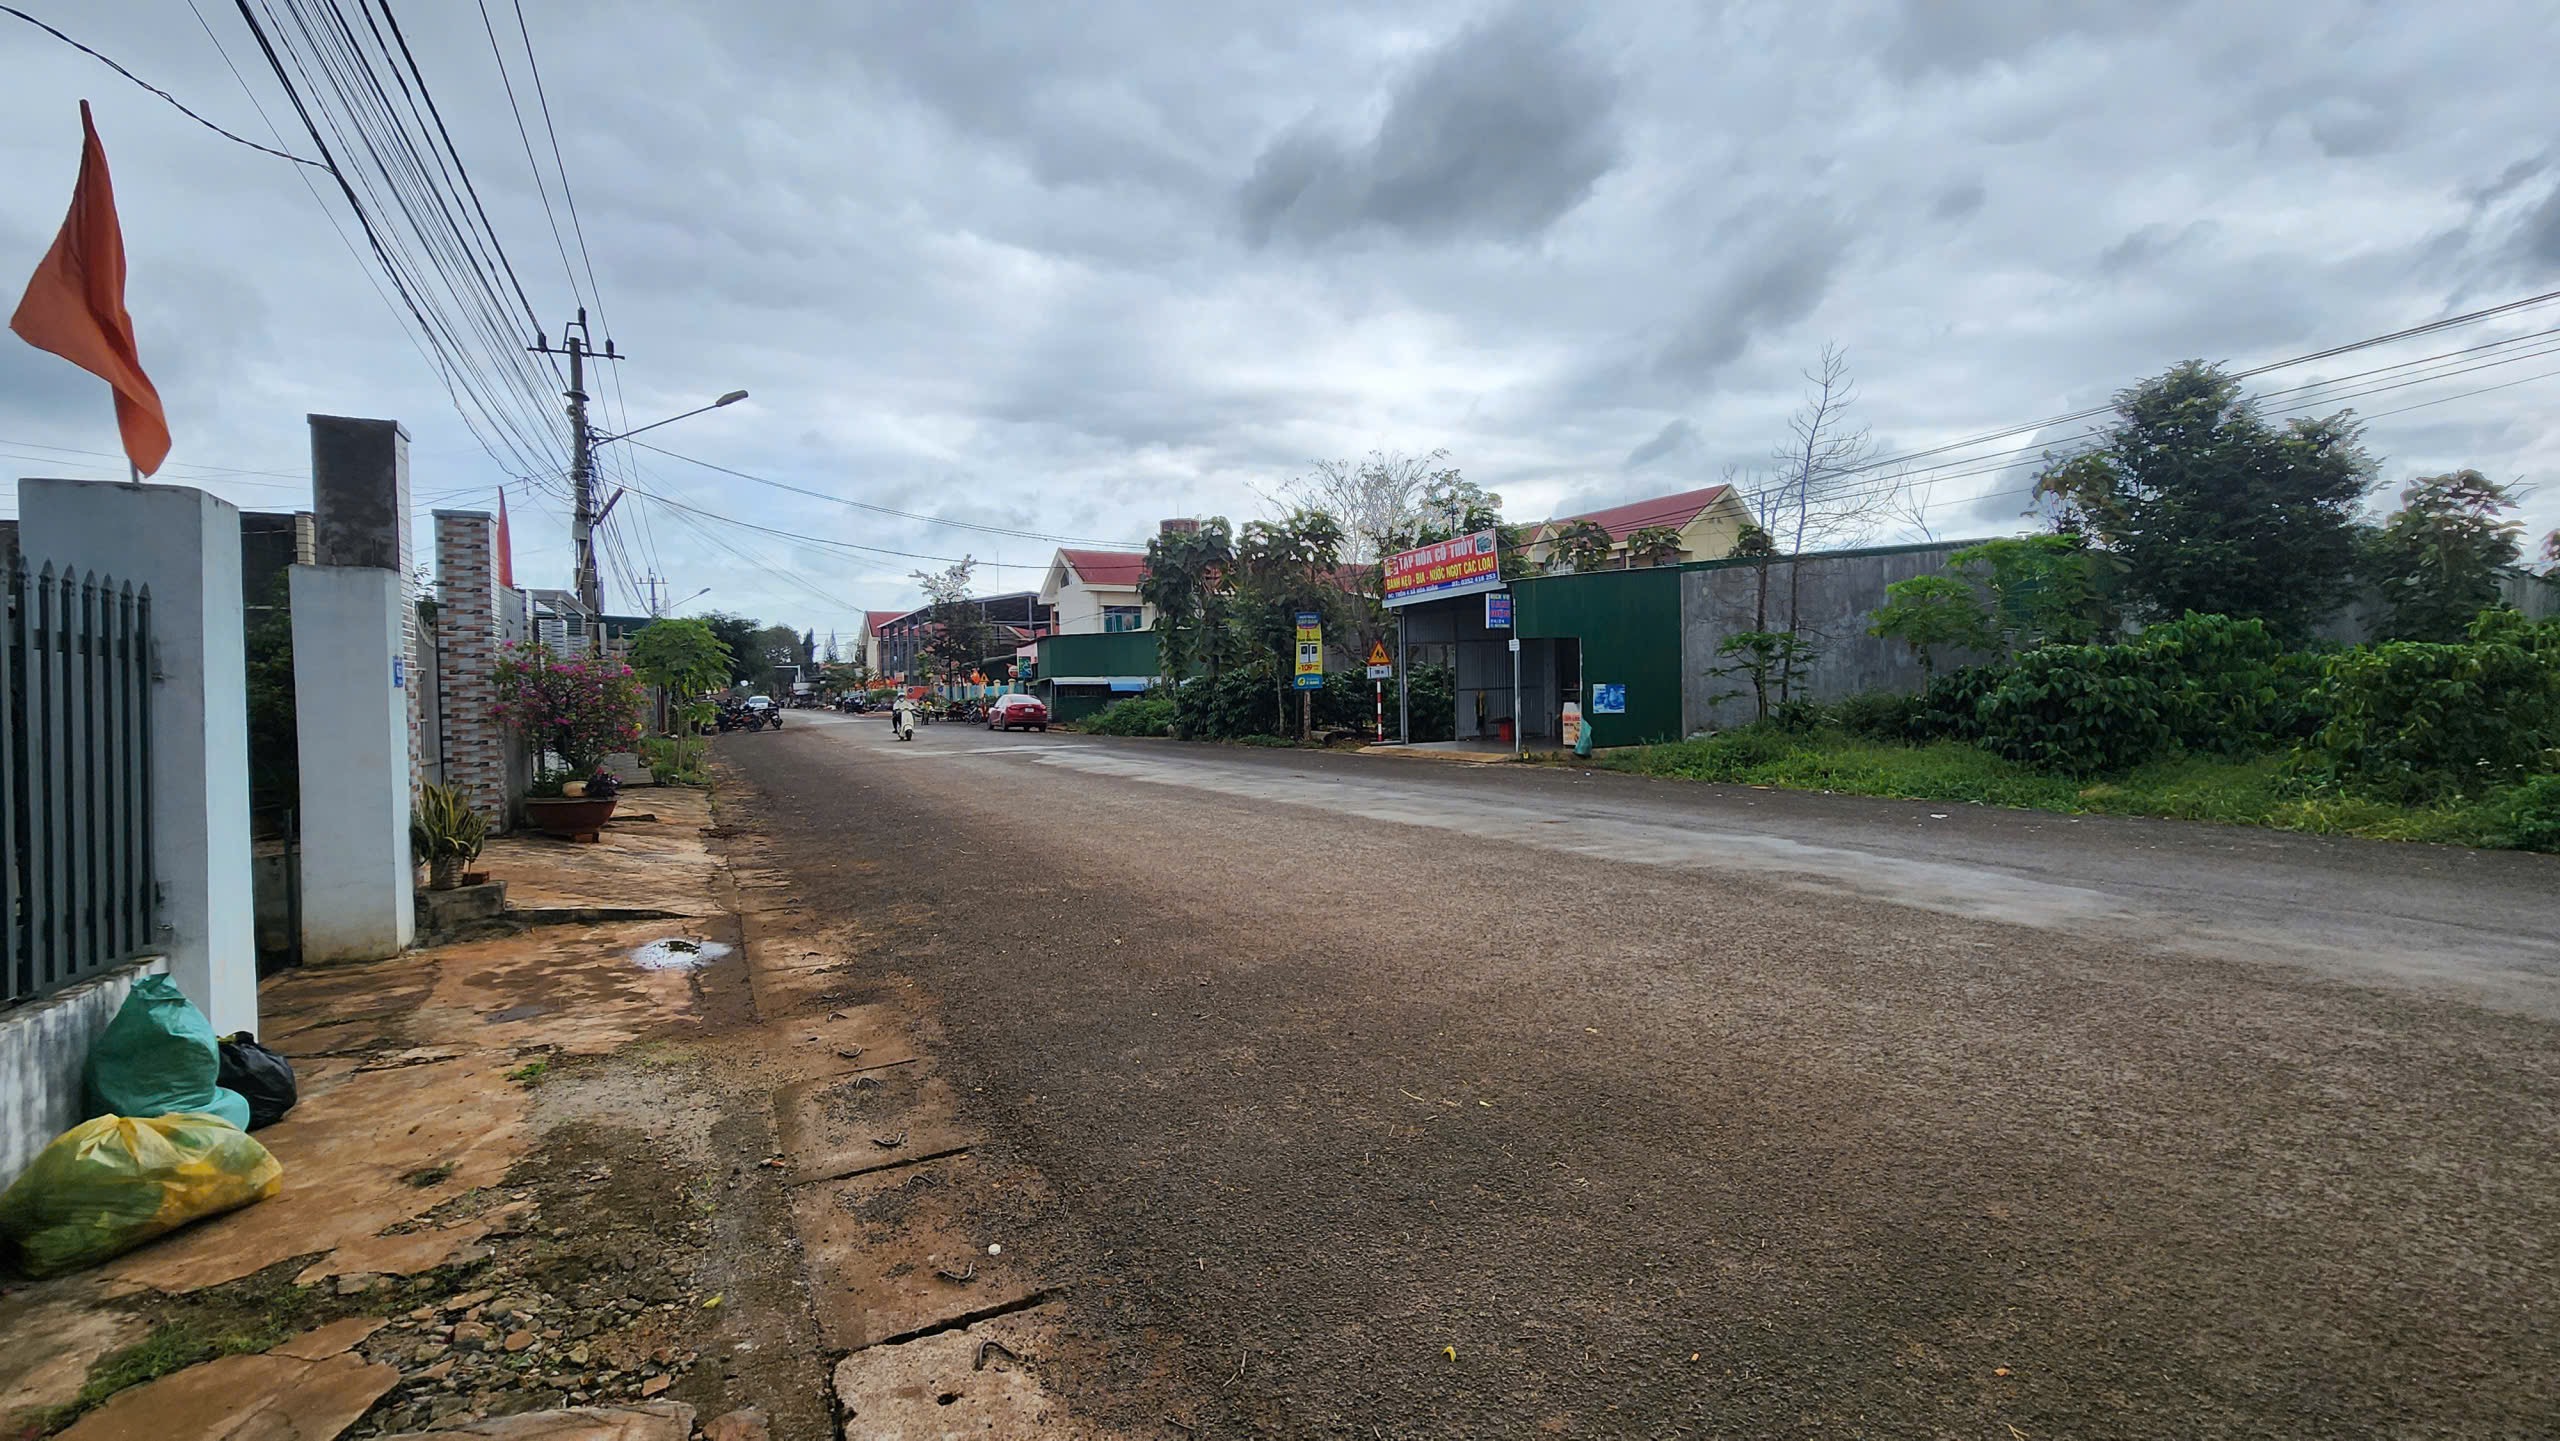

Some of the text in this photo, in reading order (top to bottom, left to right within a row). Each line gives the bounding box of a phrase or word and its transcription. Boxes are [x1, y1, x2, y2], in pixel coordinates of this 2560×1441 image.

[1398, 539, 1473, 572] TẠP HÓA CÔ THỦY
[1446, 563, 1462, 579] NGỌT
[1463, 558, 1477, 574] CÁC
[1477, 556, 1494, 572] LOẠI
